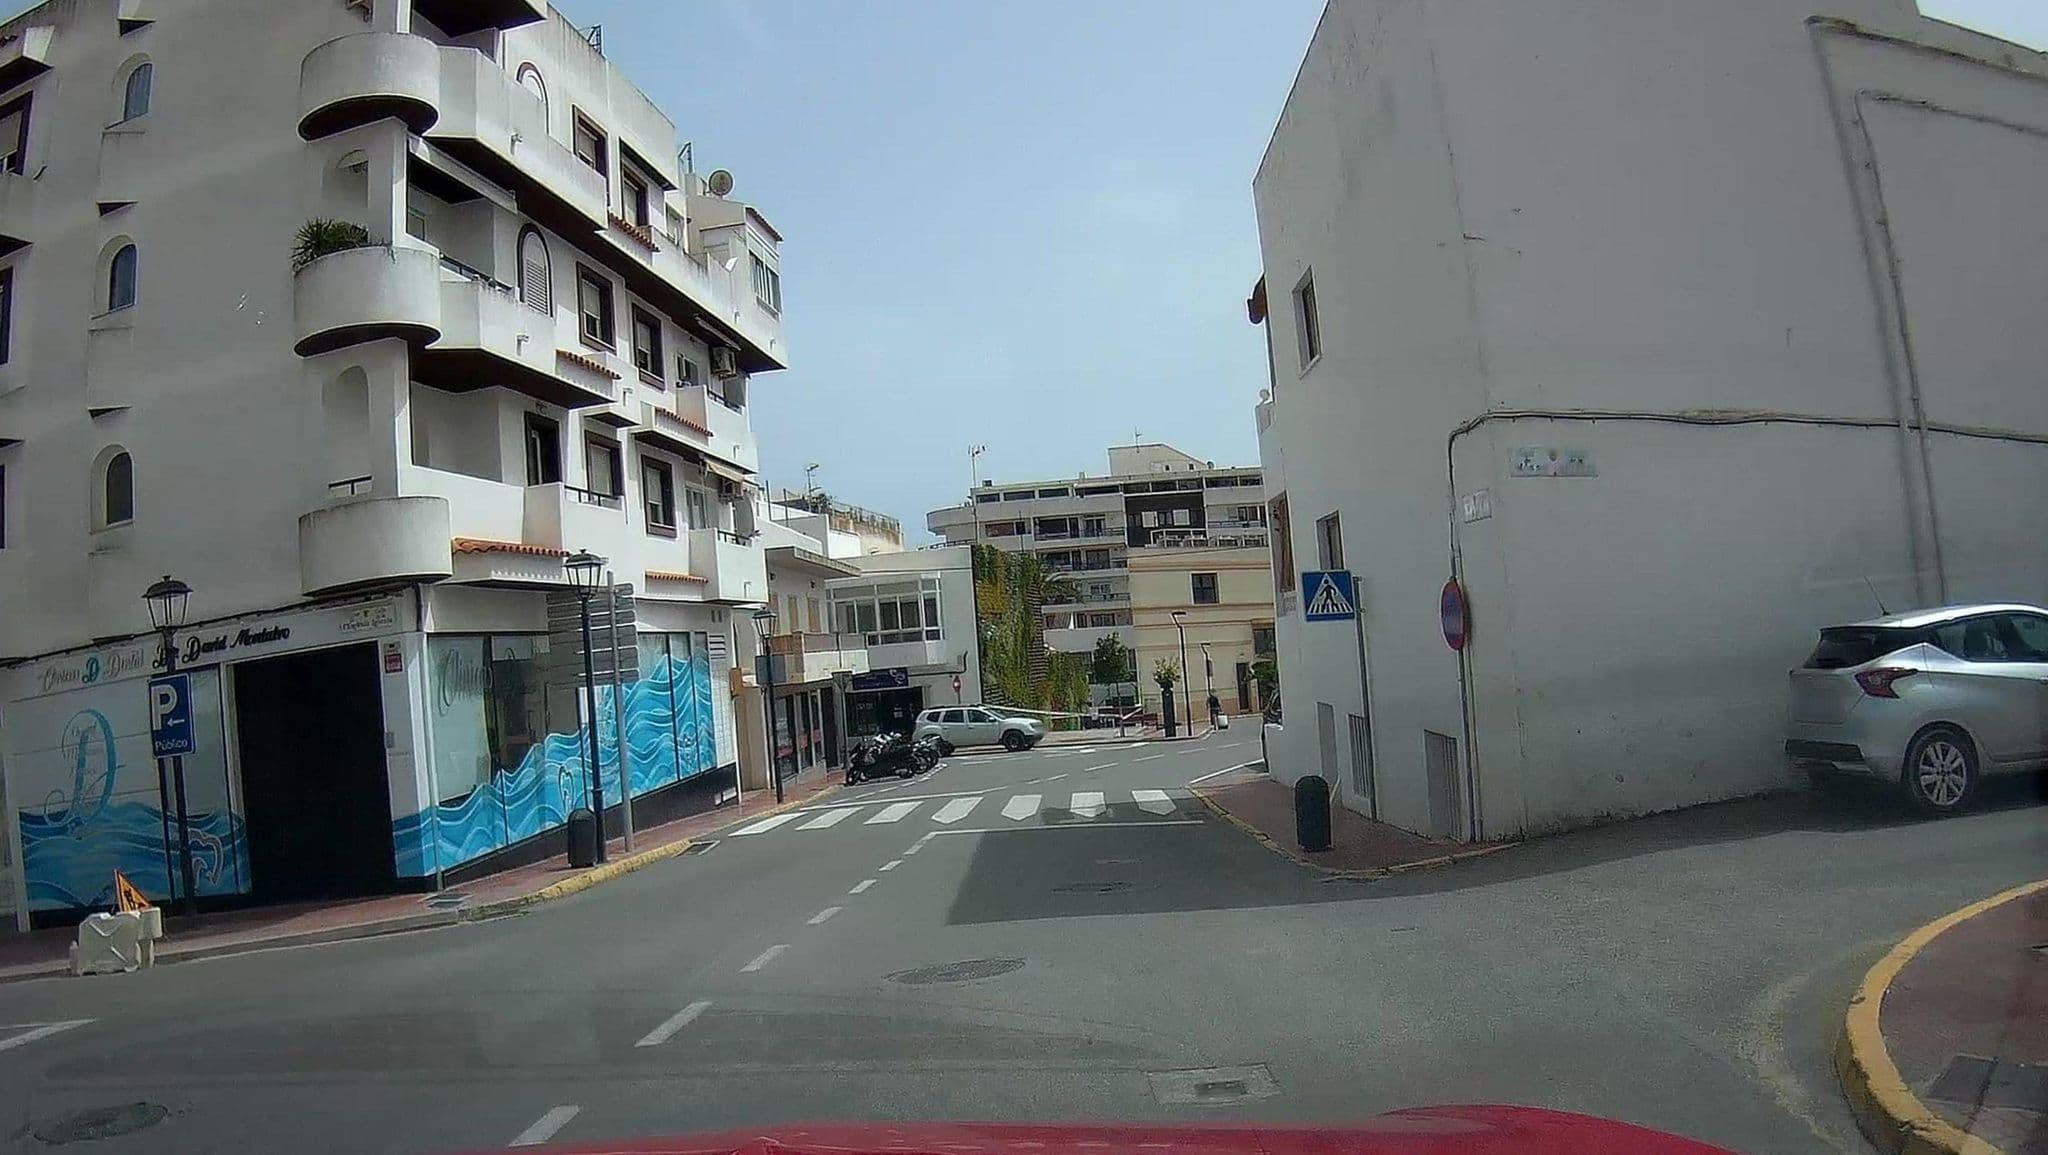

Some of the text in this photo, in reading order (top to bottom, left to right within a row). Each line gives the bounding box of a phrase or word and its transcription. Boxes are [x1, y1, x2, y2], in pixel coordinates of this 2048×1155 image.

[182, 636, 227, 664] David
[230, 626, 290, 648] Montalvo
[151, 684, 178, 731] P
[154, 739, 188, 753] Público
